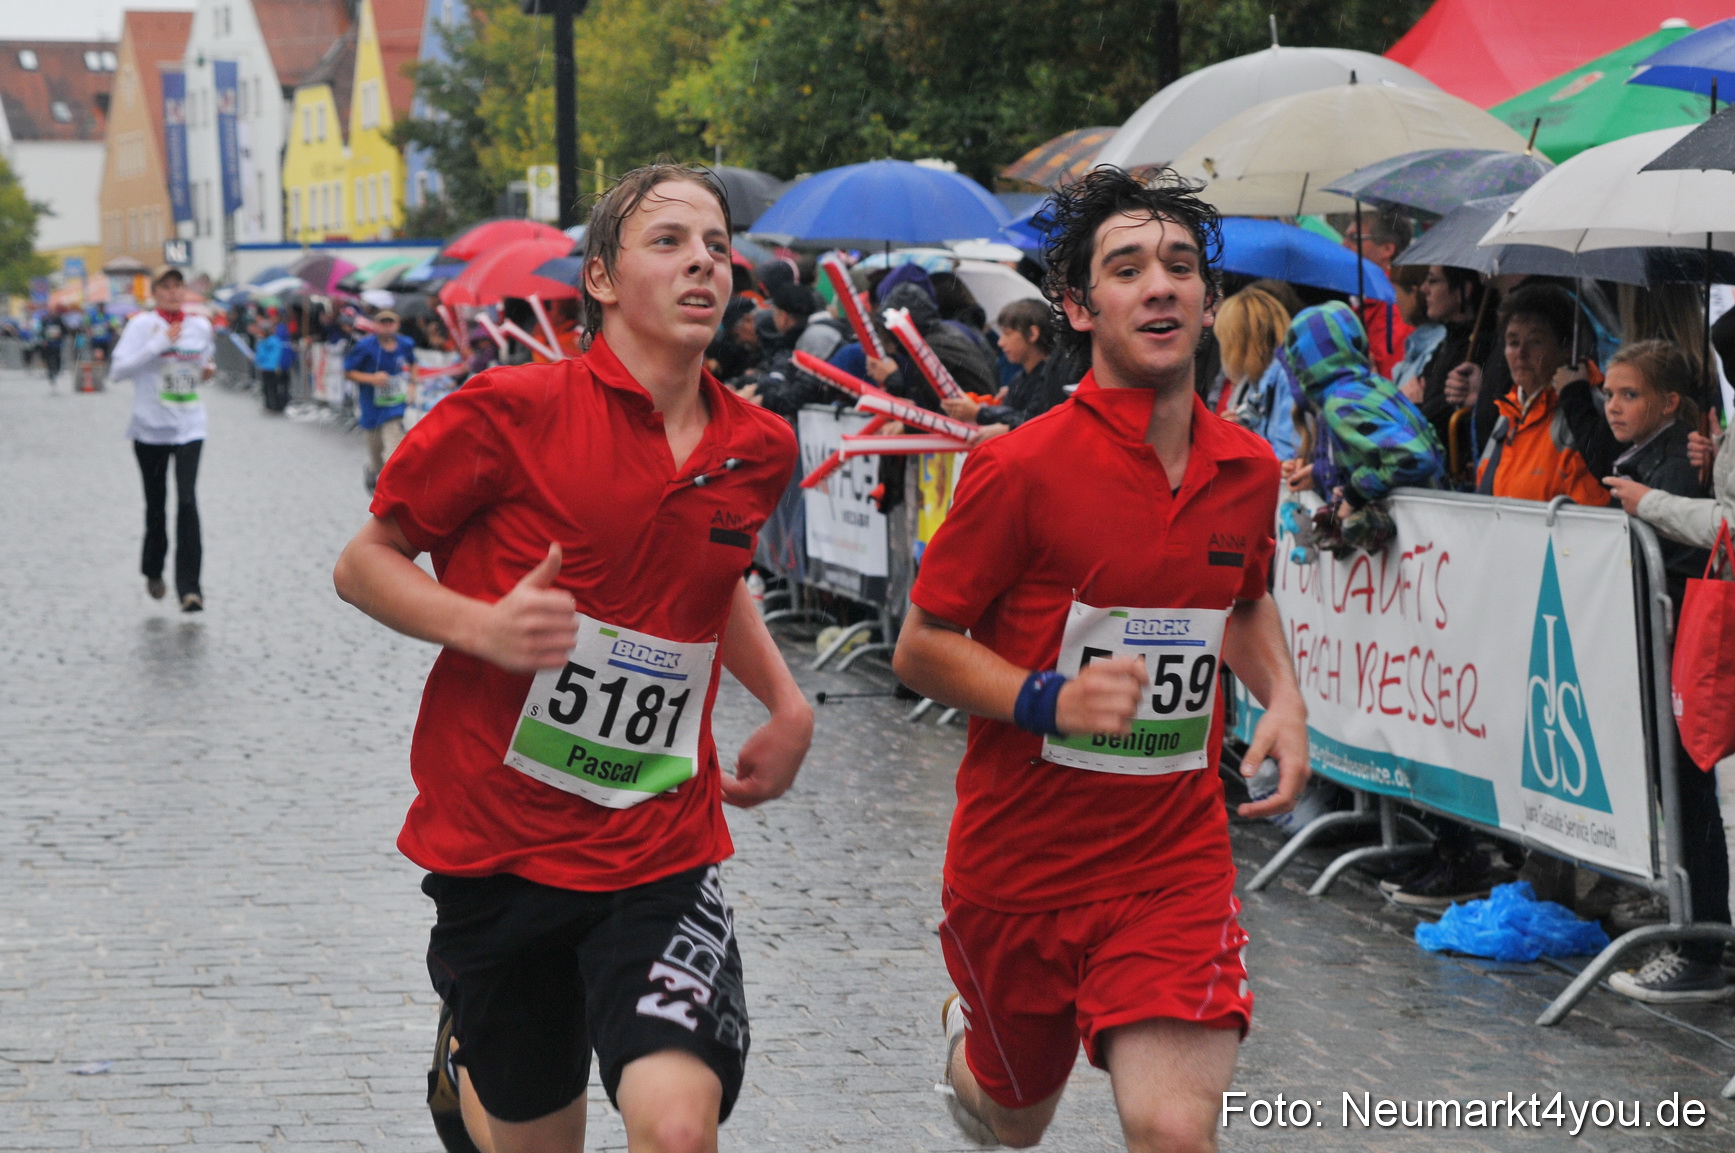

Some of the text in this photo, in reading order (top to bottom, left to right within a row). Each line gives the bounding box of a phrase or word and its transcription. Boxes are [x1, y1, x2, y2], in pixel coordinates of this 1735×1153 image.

[1124, 619, 1192, 636] BOCK
[611, 640, 683, 670] BOCK
[1078, 646, 1217, 715] 59
[548, 661, 691, 749] 5181
[565, 744, 643, 785] Pascal
